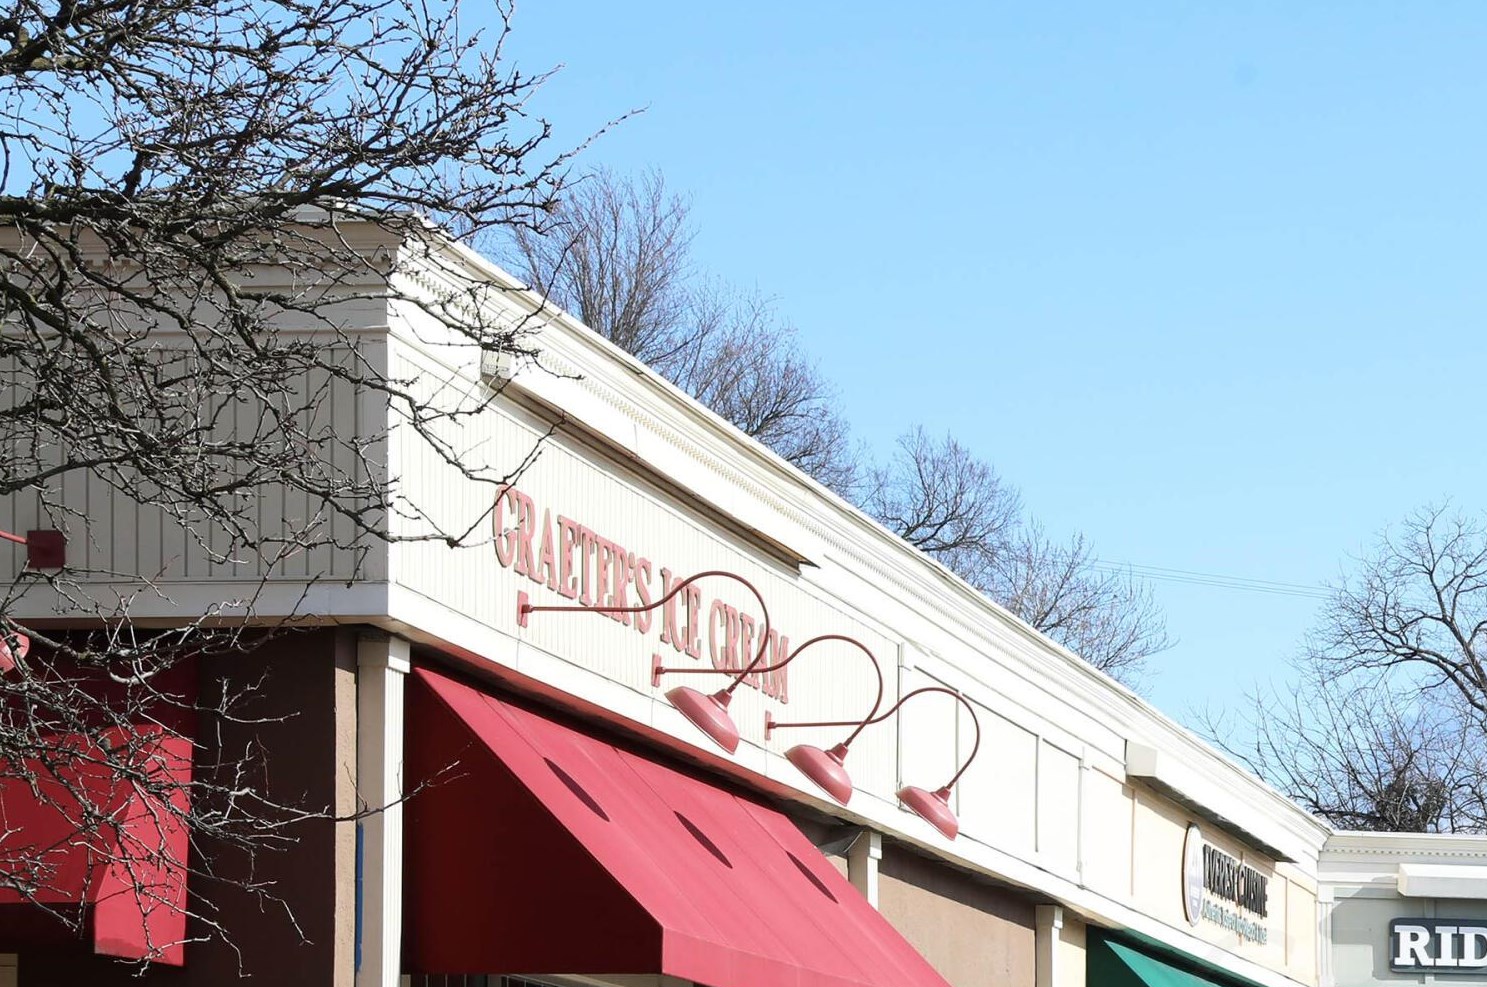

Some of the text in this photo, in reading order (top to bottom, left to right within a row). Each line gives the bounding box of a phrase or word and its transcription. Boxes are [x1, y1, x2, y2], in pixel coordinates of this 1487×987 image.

[492, 484, 790, 704] GRAETER'S ICE CREAM
